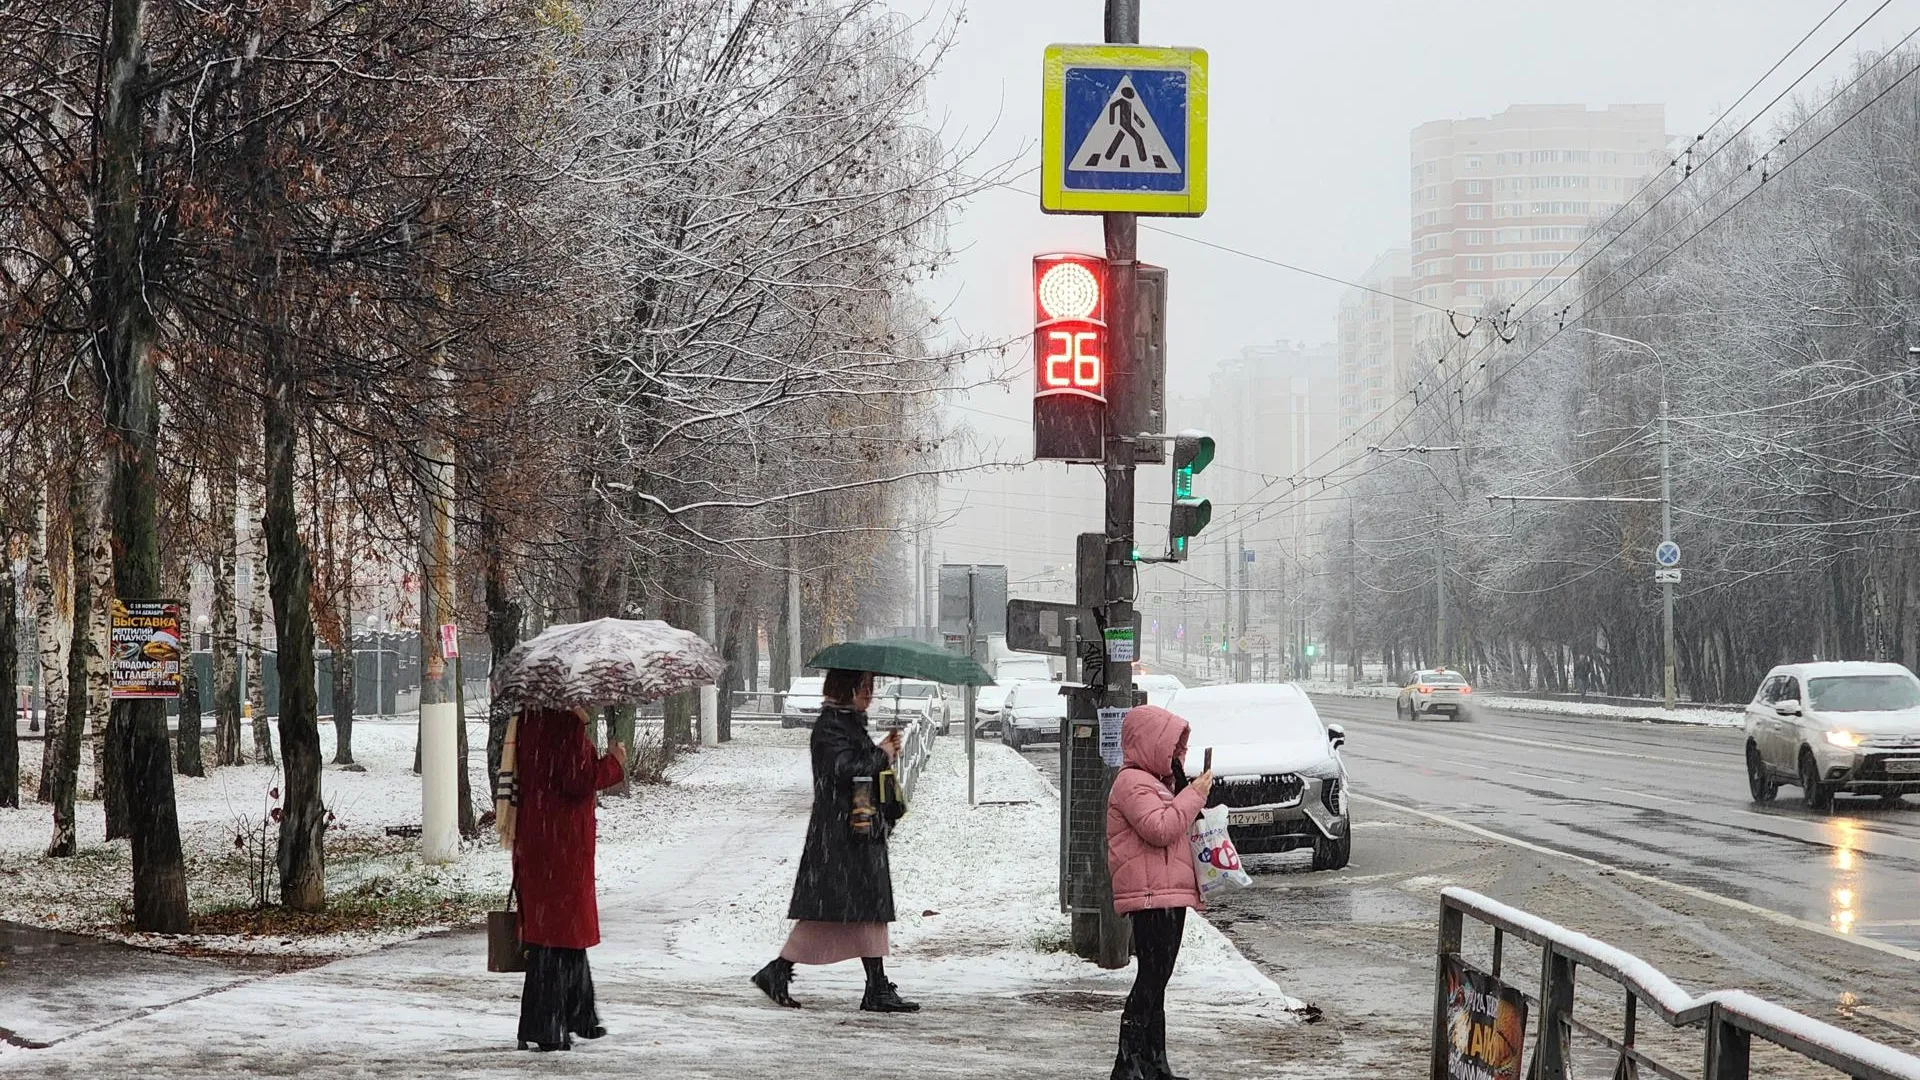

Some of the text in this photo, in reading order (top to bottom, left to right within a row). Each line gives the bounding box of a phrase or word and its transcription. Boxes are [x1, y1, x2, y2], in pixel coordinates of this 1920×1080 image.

[1046, 331, 1100, 386] 26
[113, 617, 177, 627] ВЫСТАВКА
[112, 627, 153, 635] РЕПТИЛИЙ
[113, 671, 124, 680] ТЦ
[1261, 812, 1270, 820] 18
